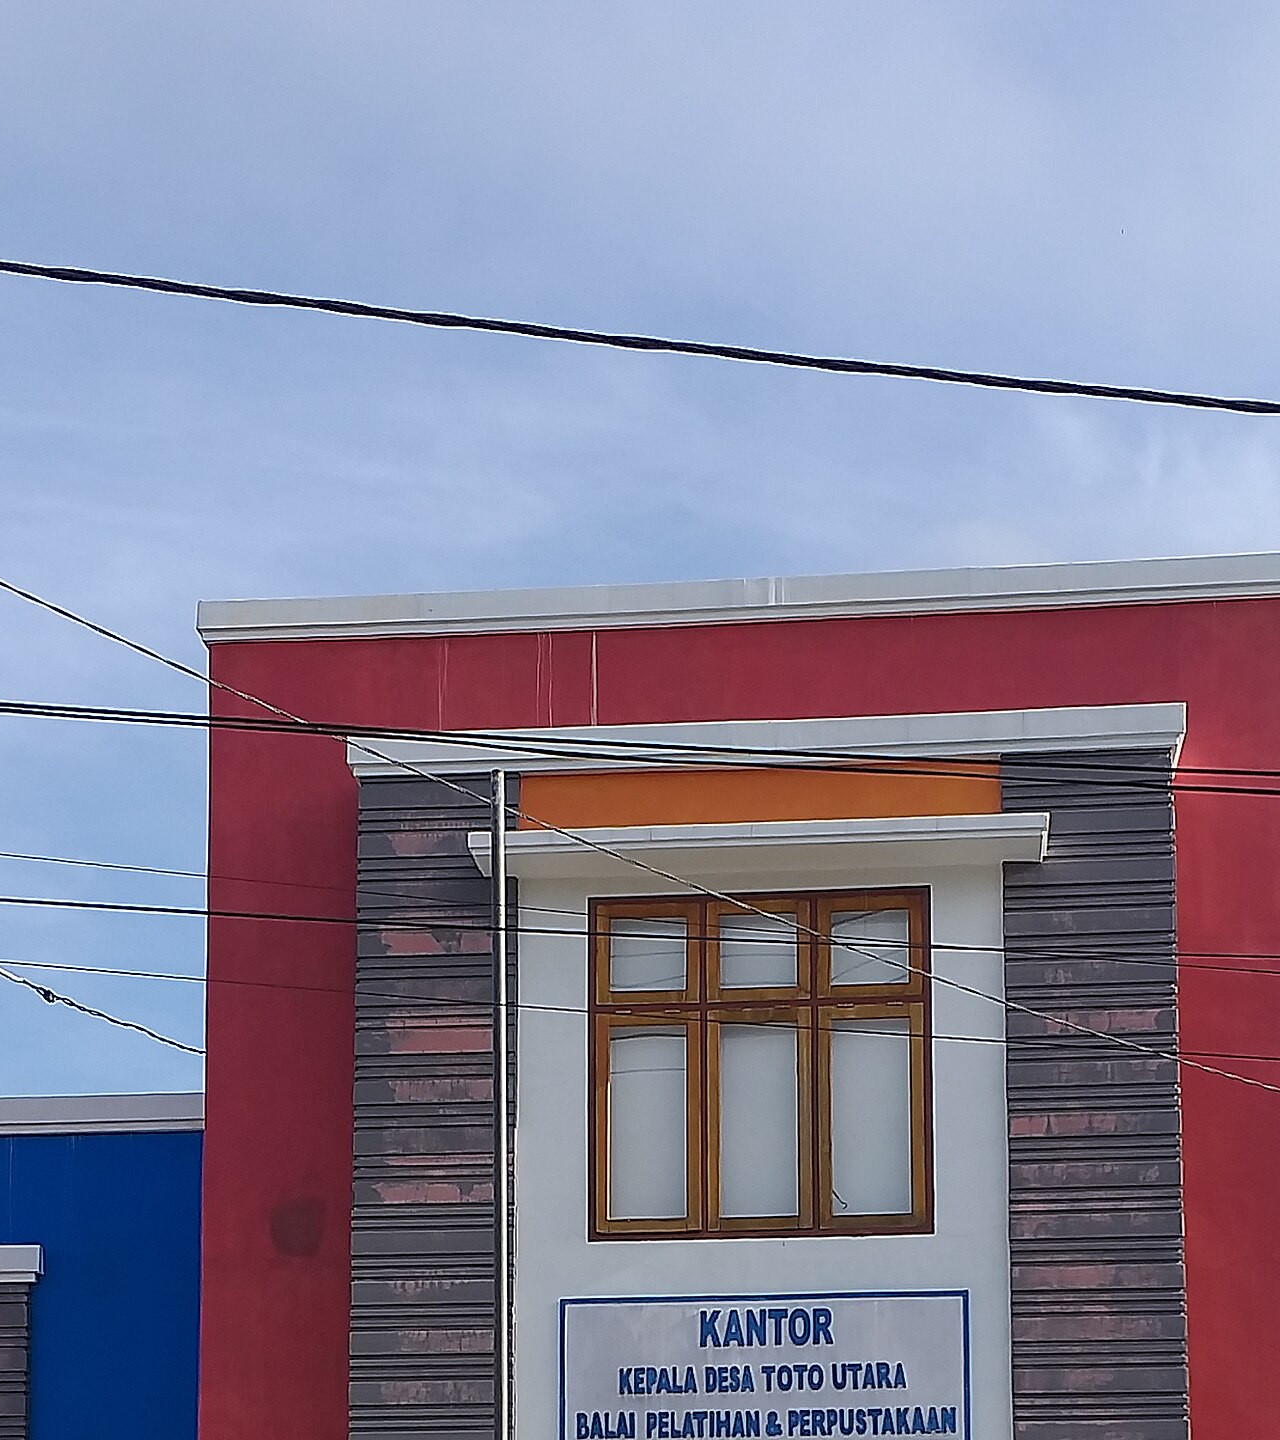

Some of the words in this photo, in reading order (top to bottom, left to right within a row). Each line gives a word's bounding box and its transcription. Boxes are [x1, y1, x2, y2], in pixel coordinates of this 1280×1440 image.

[699, 1308, 834, 1347] KANTOR
[619, 1367, 697, 1394] KEPALA
[705, 1366, 754, 1393] DESA
[762, 1364, 824, 1391] TOTO
[832, 1362, 907, 1390] UTARA
[576, 1412, 635, 1439] BALAI
[646, 1411, 761, 1439] PELATIHAN
[766, 1411, 783, 1436] &
[788, 1407, 956, 1437] PERPUSTAKAAN
